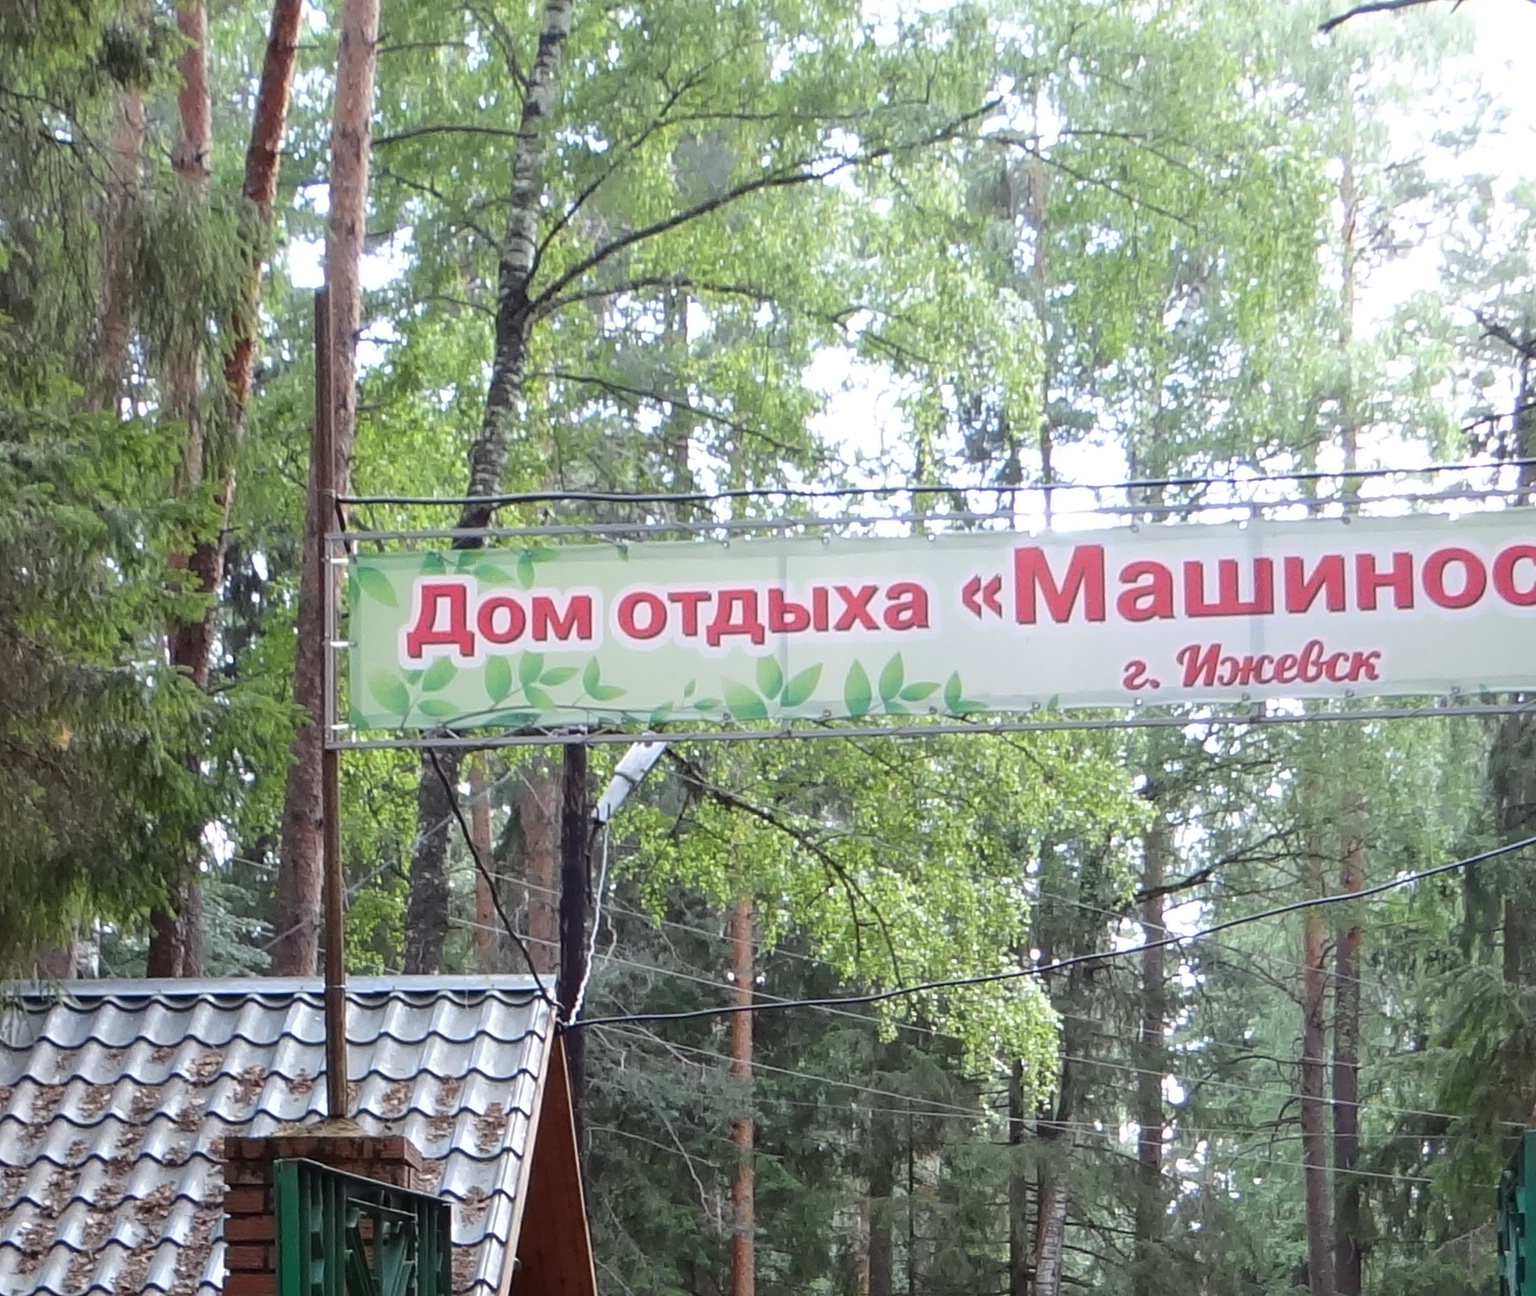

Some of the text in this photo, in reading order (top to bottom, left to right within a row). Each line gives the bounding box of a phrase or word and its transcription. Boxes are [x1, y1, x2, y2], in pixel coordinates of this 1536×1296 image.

[406, 583, 594, 657] Дом
[616, 577, 931, 647] отдыха
[1122, 640, 1383, 691] г. Ижевск
